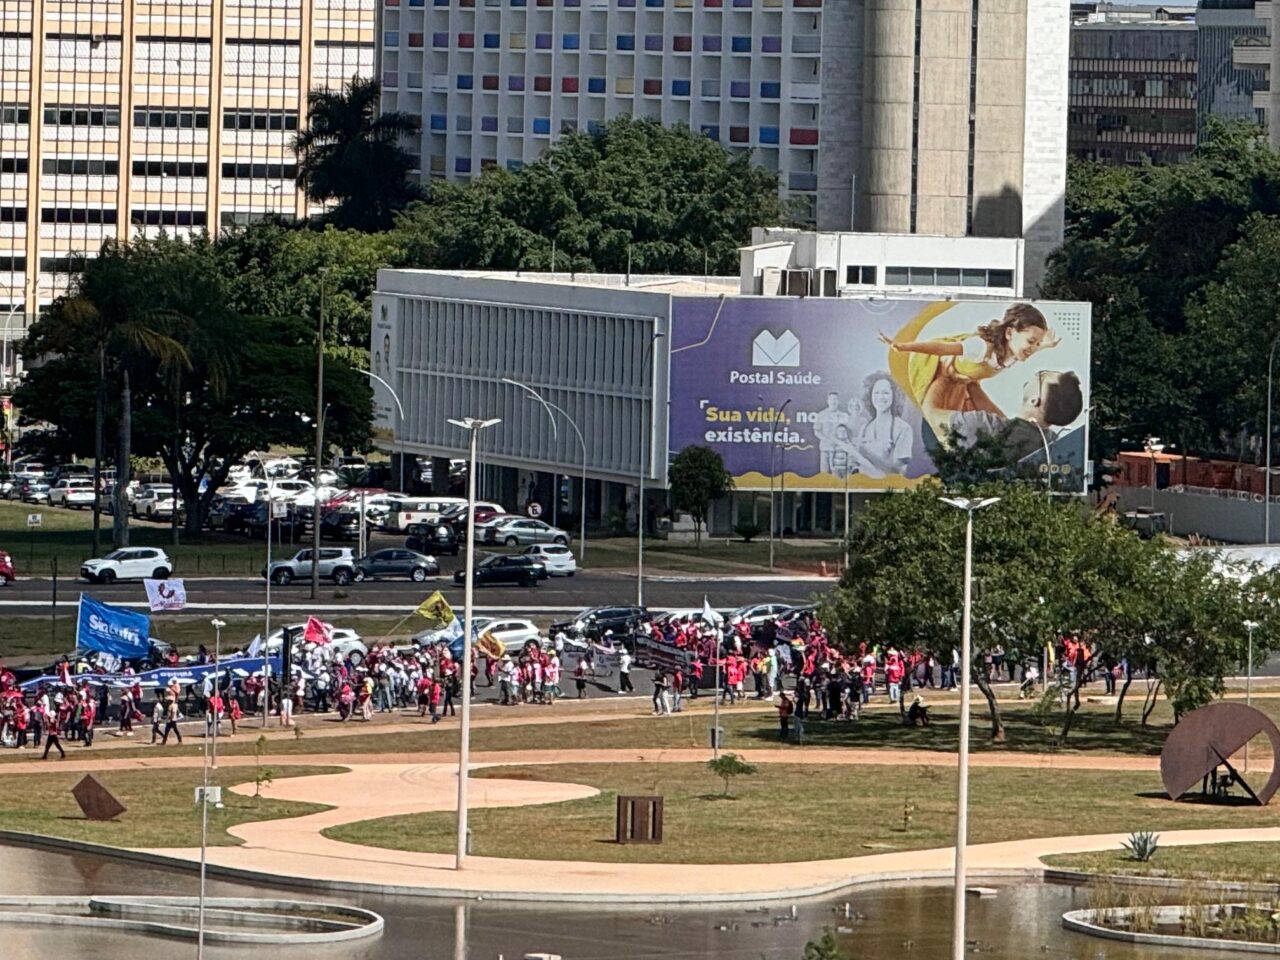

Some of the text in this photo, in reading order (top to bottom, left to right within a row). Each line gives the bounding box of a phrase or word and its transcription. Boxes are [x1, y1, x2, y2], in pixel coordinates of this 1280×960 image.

[730, 371, 821, 385] Postal Saúde
[705, 407, 742, 422] Sua
[746, 407, 791, 425] vida,
[705, 426, 806, 444] existência.
